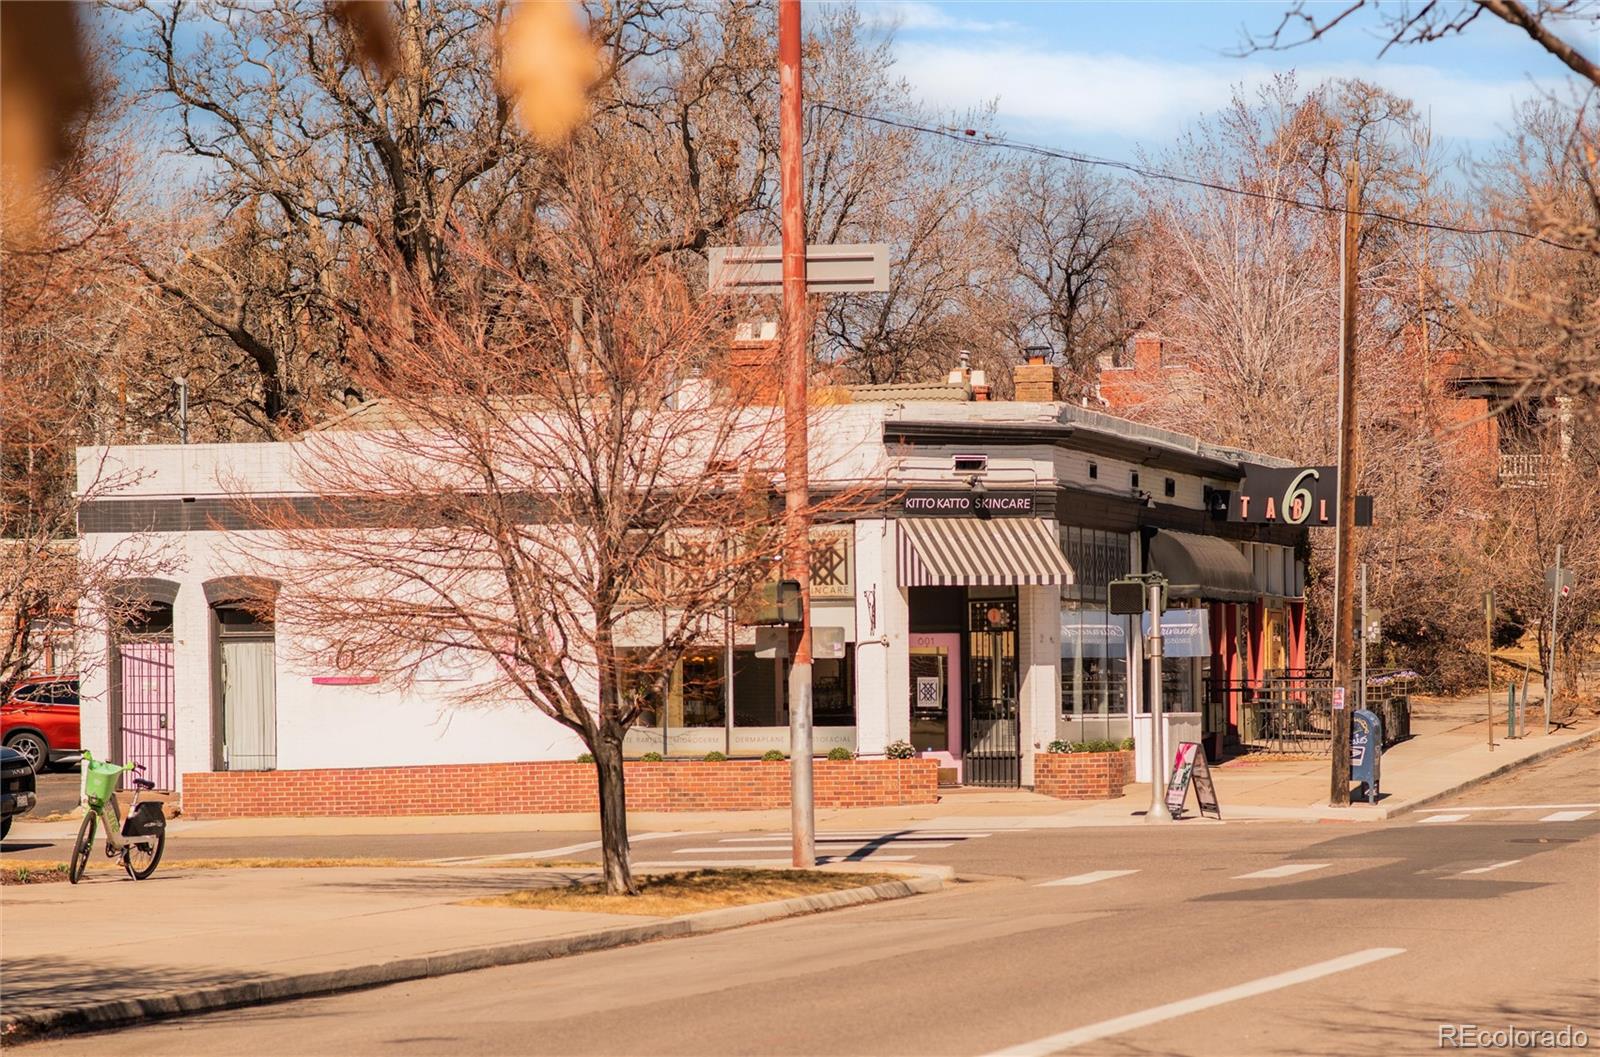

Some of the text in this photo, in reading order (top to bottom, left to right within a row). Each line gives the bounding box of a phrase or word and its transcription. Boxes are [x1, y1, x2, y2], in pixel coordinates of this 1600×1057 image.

[905, 497, 1031, 509] KITTO KATTO SKINCARE
[1240, 495, 1329, 522] TABL
[1281, 469, 1319, 525] 6
